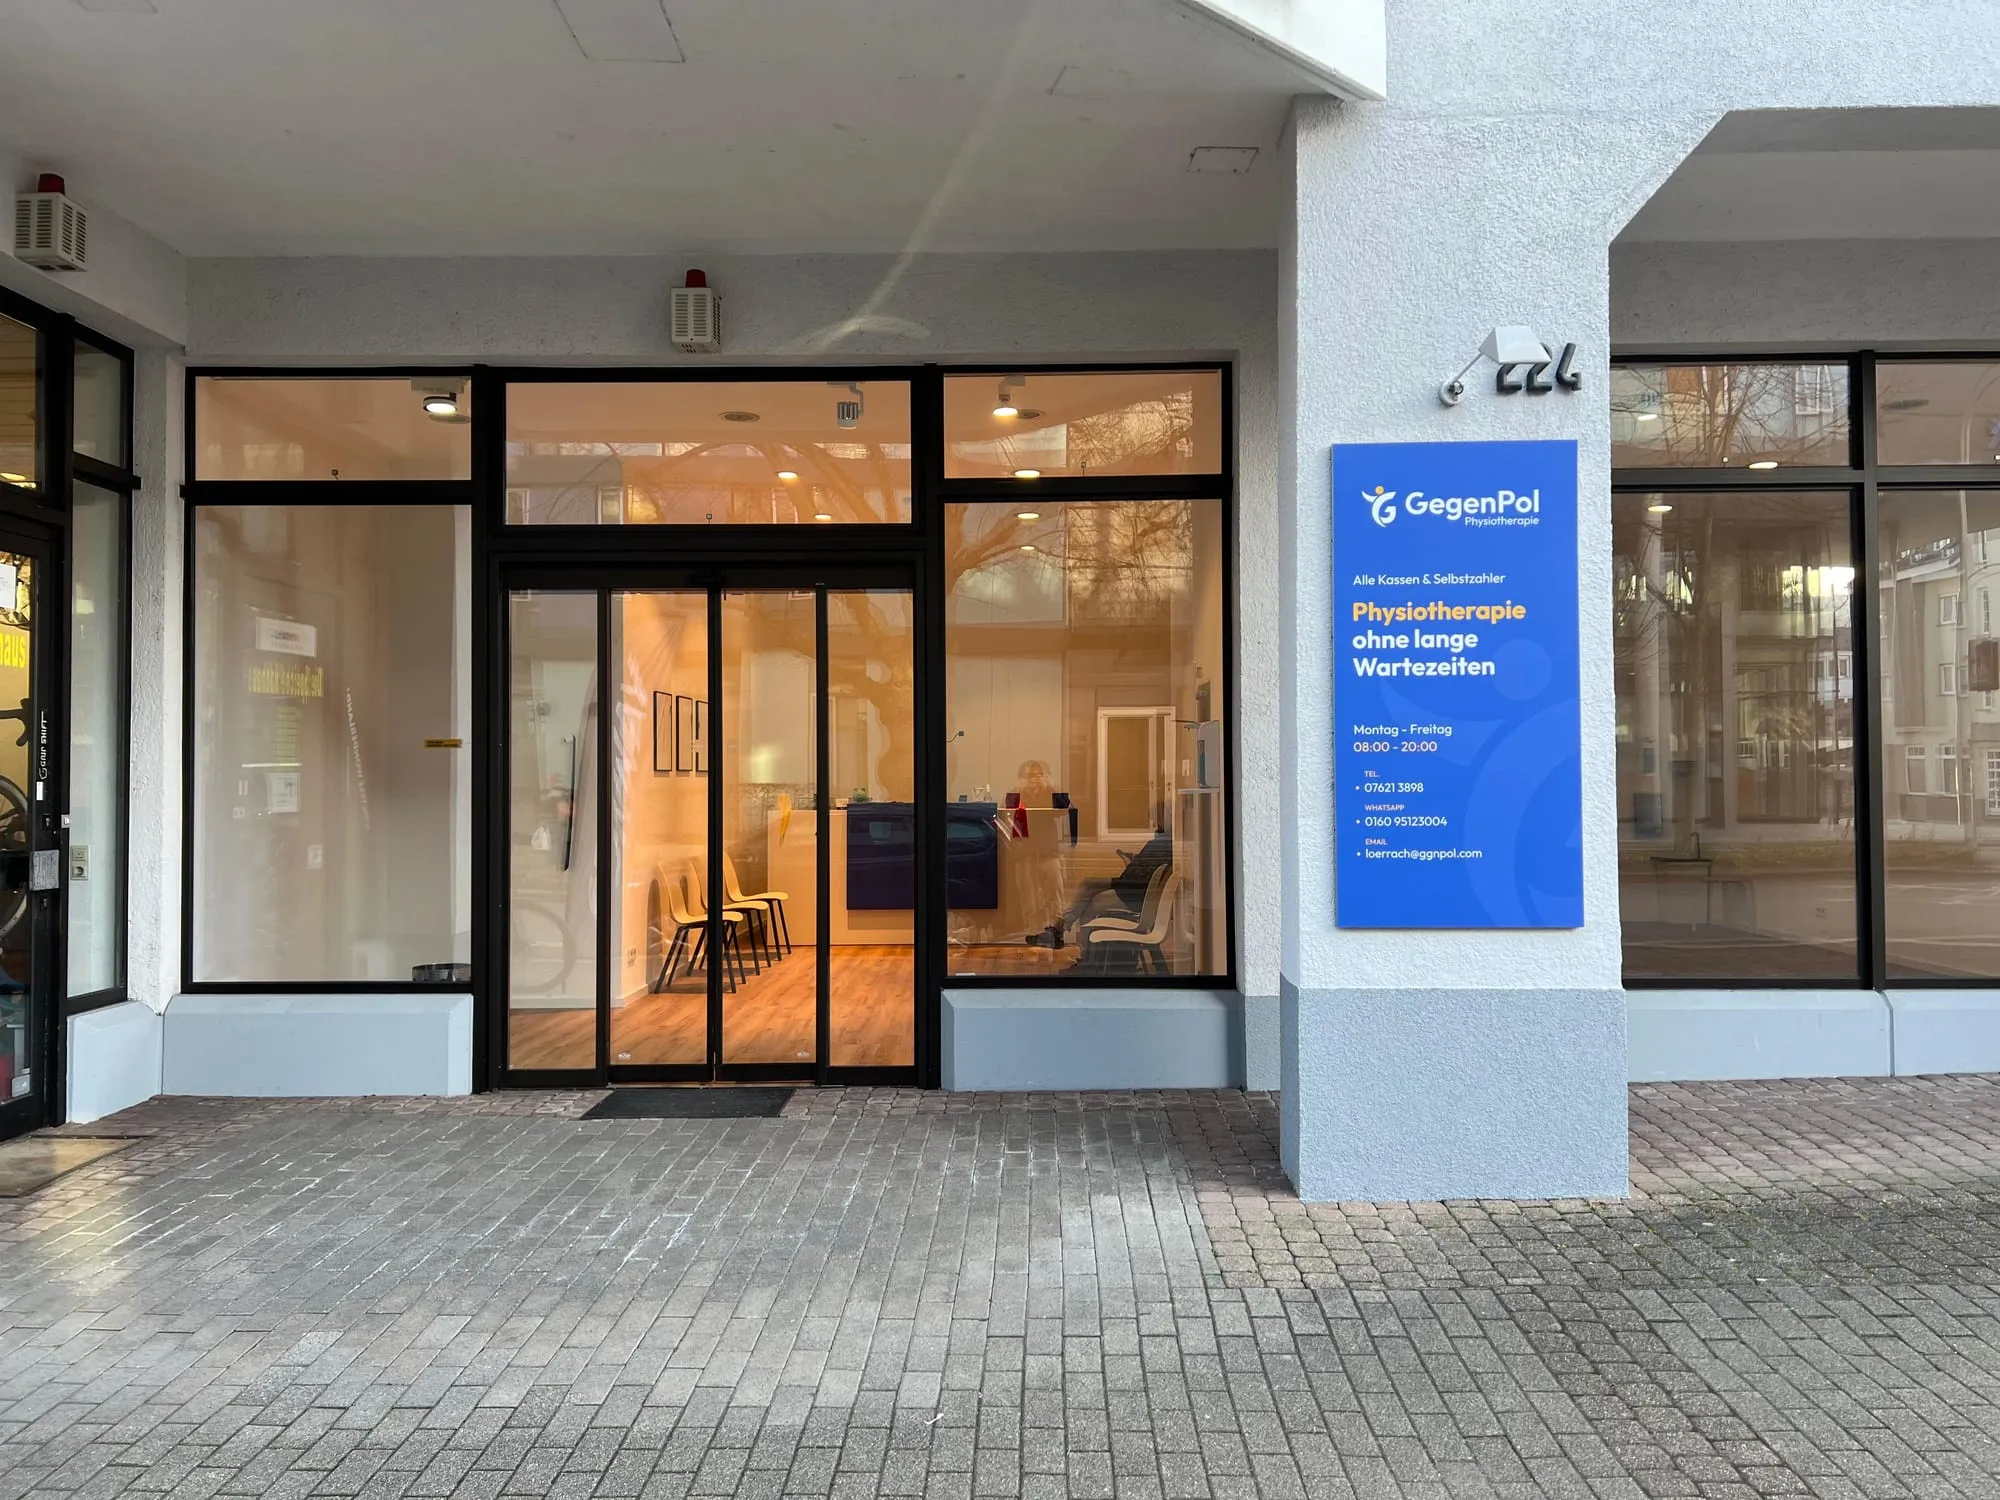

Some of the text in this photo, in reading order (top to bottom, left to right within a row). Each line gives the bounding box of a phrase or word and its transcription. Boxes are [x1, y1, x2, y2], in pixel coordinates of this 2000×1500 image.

[1405, 489, 1540, 520] GegenPol
[1465, 516, 1540, 528] Physiotherapie
[1353, 573, 1506, 586] Alle Kassen & Selbstzahler
[1353, 600, 1526, 626] Physiotherapie
[1352, 629, 1479, 653] ohne lange
[1353, 656, 1496, 677] Wartezeiten
[1353, 725, 1399, 737] Montag
[1410, 724, 1453, 737] Freitag
[1353, 742, 1390, 753] 08:00
[1401, 741, 1438, 752] 20:00
[1364, 783, 1424, 793] 07621 3898
[1365, 804, 1405, 812] WHATSAPP
[1365, 816, 1448, 827] 0160 95123004
[1365, 838, 1388, 846] EMAIL
[1365, 848, 1483, 861] loerrach@ggnpol.com
